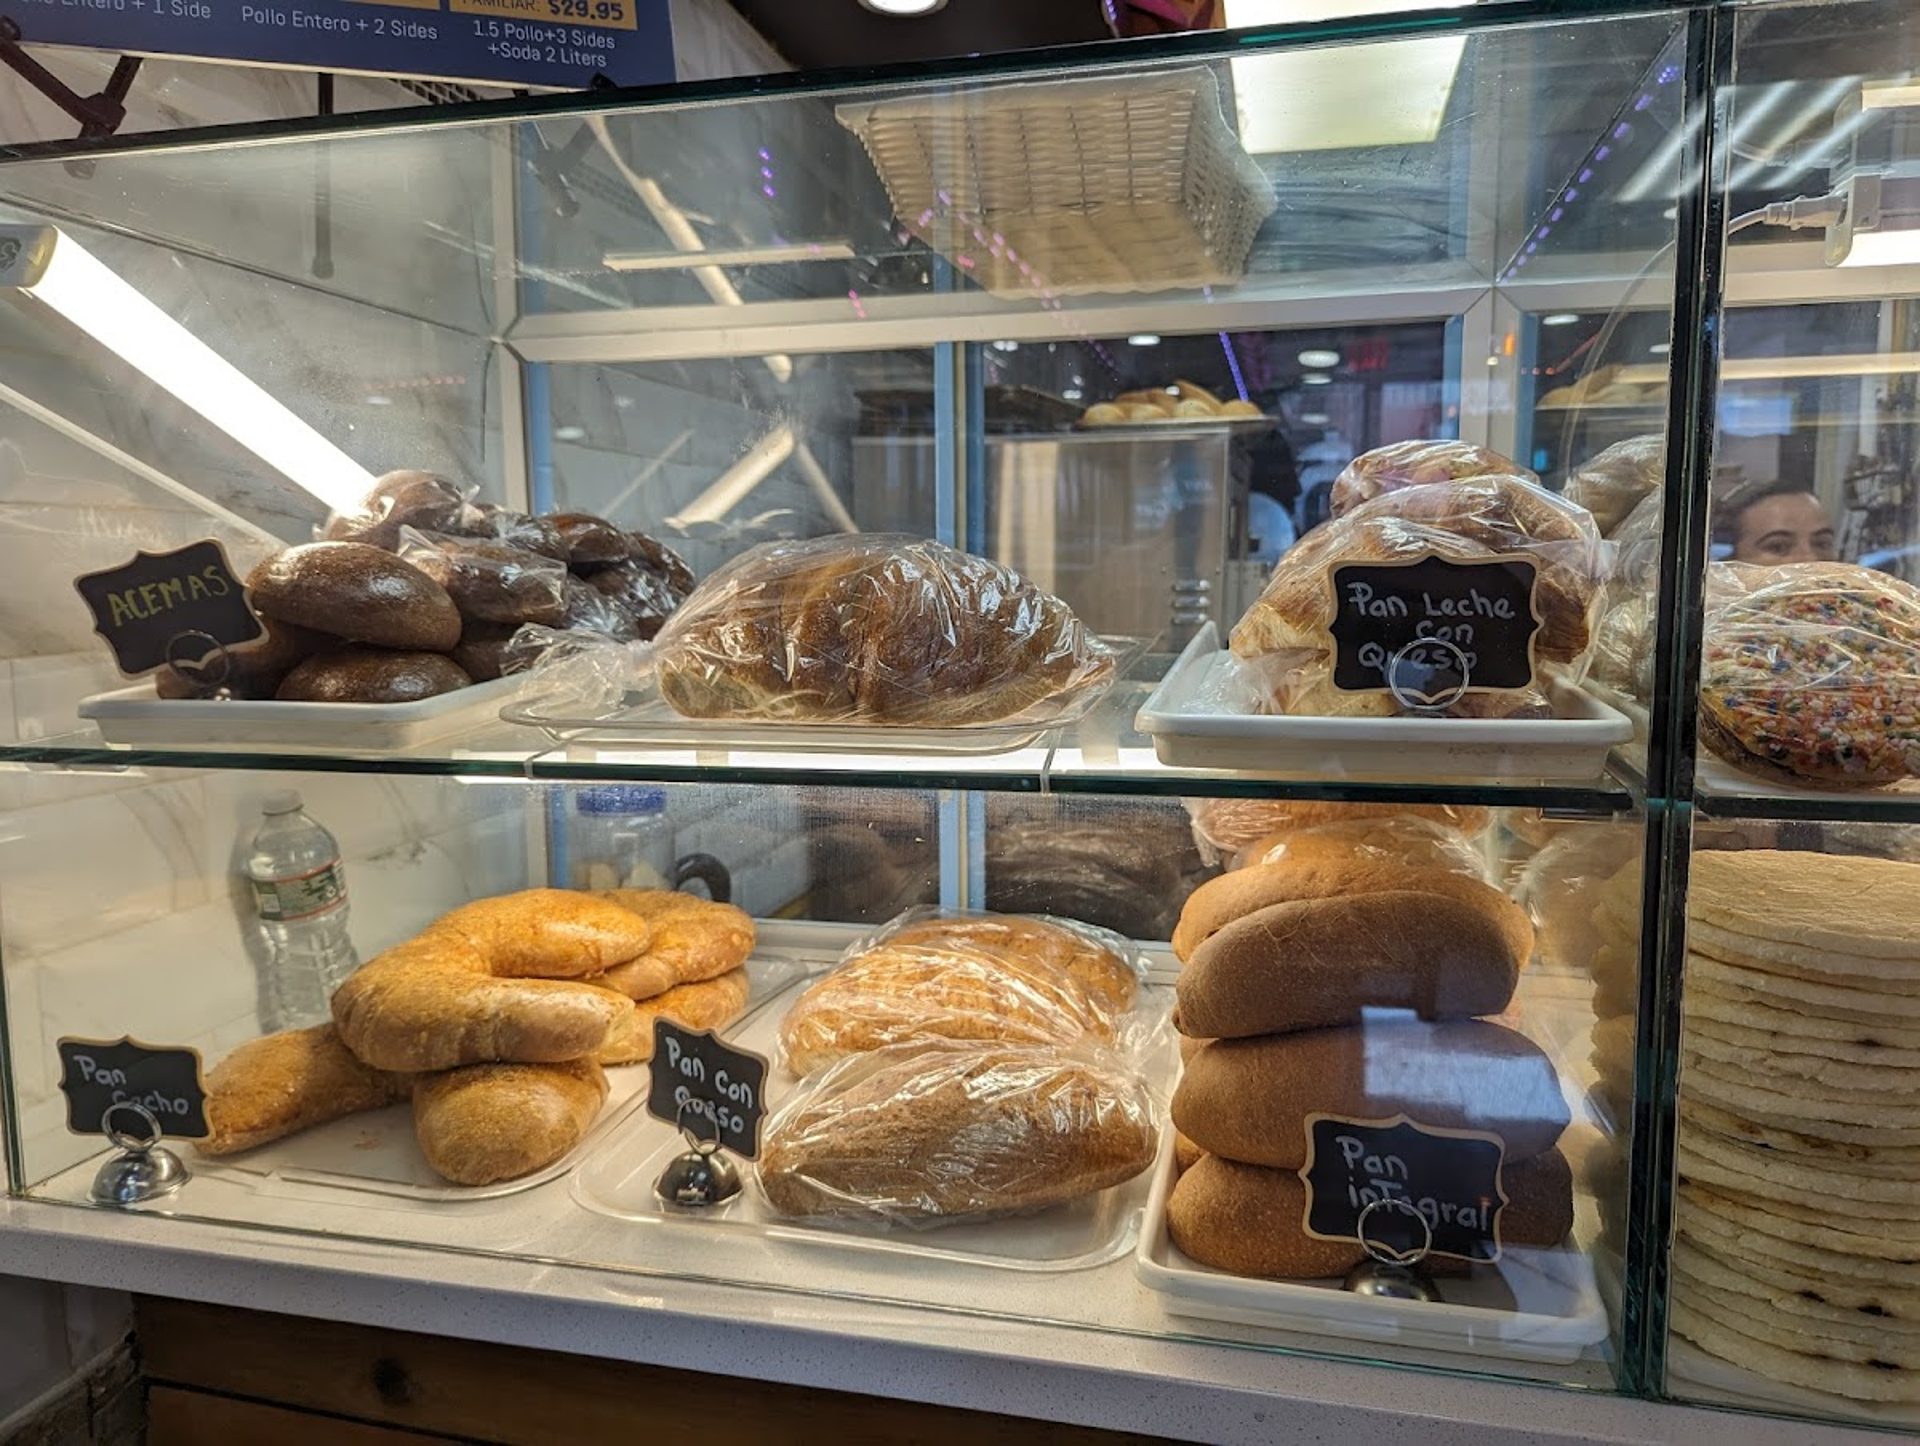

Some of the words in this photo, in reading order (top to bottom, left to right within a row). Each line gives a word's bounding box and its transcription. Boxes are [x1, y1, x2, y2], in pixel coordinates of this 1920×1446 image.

[153, 0, 165, 14] 1
[171, 0, 211, 18] Side
[242, 6, 286, 26] Pollo
[292, 11, 350, 32] Entero
[355, 18, 369, 31] +
[374, 19, 385, 35] 2
[391, 20, 438, 40] Sides
[549, 0, 625, 21] $29.95
[473, 20, 500, 38] 1.5
[571, 30, 616, 49] Sides
[488, 43, 541, 61] +Soda
[546, 47, 556, 63] 2
[561, 49, 607, 68] Liters
[107, 565, 229, 627] ACEMAS
[1347, 581, 1408, 617] Pan
[1423, 588, 1516, 619] Leche
[73, 1055, 127, 1086] Pan
[665, 1036, 705, 1083] Pan
[1336, 1136, 1408, 1180] Pan
